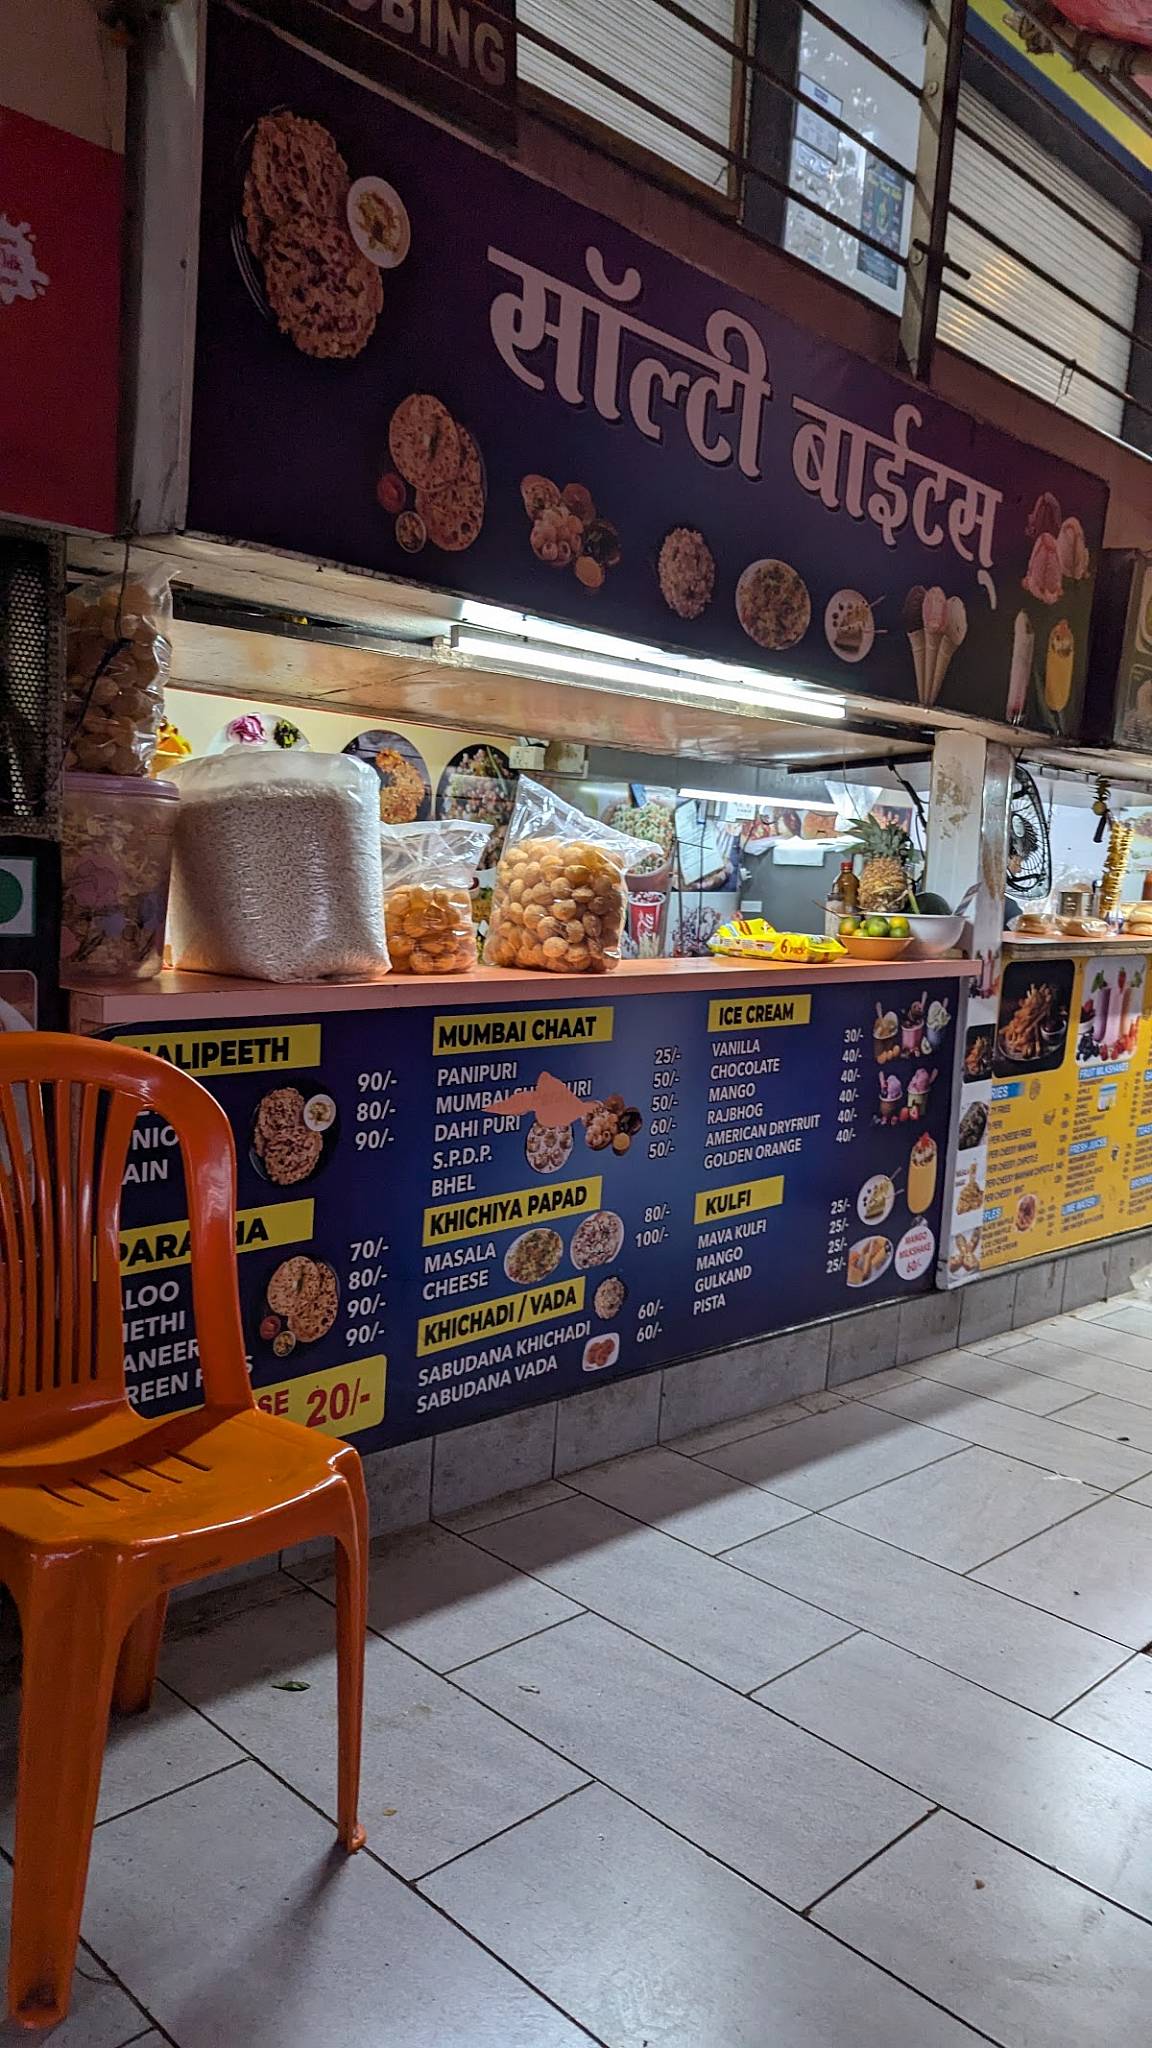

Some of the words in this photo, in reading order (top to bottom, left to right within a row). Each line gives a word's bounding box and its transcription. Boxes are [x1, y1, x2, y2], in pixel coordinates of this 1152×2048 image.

[348, 0, 506, 86] BING
[780, 939, 788, 954] 6
[718, 1006, 743, 1026] ICE
[746, 1002, 795, 1023] CREAM
[438, 1020, 526, 1048] MUMBAI
[531, 1016, 597, 1040] CHAAT
[711, 1038, 761, 1057] VANILLA
[843, 1028, 864, 1043] 30/-
[131, 1036, 289, 1069] ALIPEETH
[436, 1062, 518, 1087] PANIPURI
[653, 1047, 682, 1065] 25/-
[710, 1058, 781, 1080] CHOCOLATE
[841, 1049, 863, 1063] 40/-
[357, 1070, 398, 1092] 90/-
[564, 1079, 592, 1098] URI
[652, 1071, 680, 1089] 50/-
[708, 1082, 756, 1103] MANGO
[840, 1069, 861, 1083] 40/-
[356, 1100, 396, 1122] 80/-
[434, 1119, 478, 1142] DAHI
[483, 1114, 520, 1135] PURI
[651, 1094, 678, 1112] 50/-
[707, 1102, 764, 1125] RAJBHOG
[838, 1088, 860, 1104] 40/-
[132, 1124, 180, 1151] NIO
[355, 1128, 394, 1151] 90/-
[432, 1144, 493, 1170] S.P.D.P.
[649, 1117, 677, 1136] 60/-
[705, 1123, 768, 1148] AMERICAN
[769, 1113, 821, 1135] DRYFRUIT
[837, 1107, 858, 1124] 40/-
[703, 1148, 753, 1170] GOLDEN
[755, 1138, 802, 1159] ORANGE
[835, 1127, 857, 1143] 40/-
[121, 1158, 168, 1186] AIN
[431, 1174, 476, 1198] BHEL
[648, 1140, 675, 1159] 50/-
[429, 1198, 522, 1237] KHICHIYA
[528, 1185, 588, 1216] PAPAD
[705, 1189, 752, 1217] KULFI
[424, 1242, 497, 1274] MASALA
[644, 1204, 671, 1223] 80/-
[697, 1230, 734, 1250] MAVA
[735, 1219, 767, 1238] KULFI
[830, 1199, 851, 1215] 25/-
[350, 1237, 389, 1262] 70/-
[696, 1246, 743, 1271] MANGO
[828, 1218, 850, 1235] 25/-
[348, 1265, 387, 1290] 80/-
[422, 1269, 489, 1300] CHEESE
[635, 1227, 669, 1248] 100/-
[694, 1265, 753, 1294] GULKAND
[827, 1237, 848, 1254] 25/-
[122, 1280, 180, 1312] LOO
[693, 1293, 726, 1316] PISTA
[825, 1257, 847, 1274] 25/-
[347, 1293, 386, 1318] 90/-
[424, 1302, 514, 1346] KHICHADI
[530, 1286, 577, 1315] VADA
[346, 1321, 385, 1347] 90/-
[417, 1344, 513, 1387] SABUDANA
[516, 1320, 592, 1357] KHICHADI
[638, 1299, 664, 1320] 60/-
[123, 1338, 200, 1374] ANEER
[416, 1370, 512, 1414] SABUDANA
[515, 1355, 558, 1381] VADA
[636, 1322, 663, 1343] 60/-
[125, 1371, 188, 1405] REEN
[306, 1376, 370, 1428] 20/-
